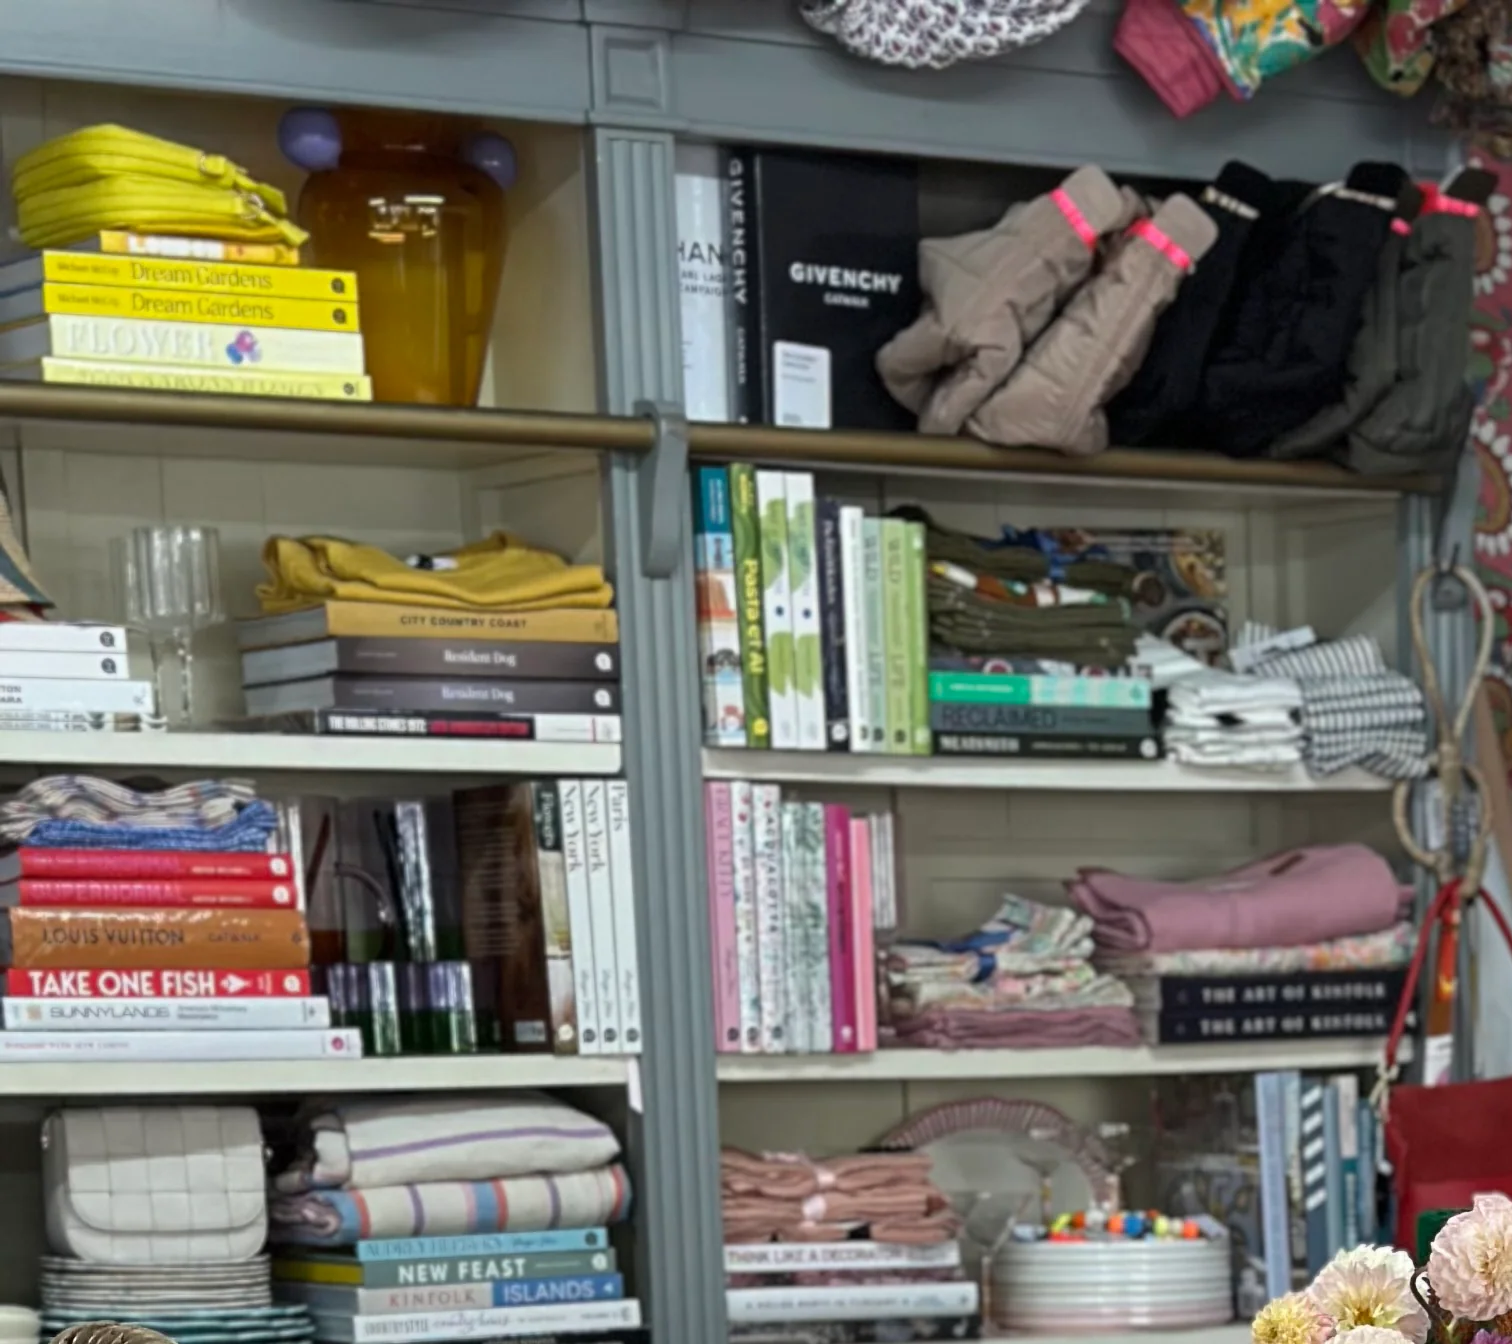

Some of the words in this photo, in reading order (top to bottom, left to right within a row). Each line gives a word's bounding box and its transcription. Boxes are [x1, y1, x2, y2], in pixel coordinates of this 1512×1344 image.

[729, 159, 748, 305] GIVENCHY
[130, 262, 193, 284] Dream
[196, 266, 273, 290] Gardens
[788, 262, 903, 295] GIVENCHY
[131, 293, 193, 315] Dream
[196, 297, 274, 321] Gardens
[744, 559, 761, 622] Pasta
[400, 615, 426, 626] CITY
[430, 616, 486, 628] COUNTRY
[489, 617, 527, 629] COAST
[611, 784, 628, 832] Paris
[43, 928, 99, 945] LOUIS
[104, 928, 185, 945] VUITTON
[28, 971, 93, 996] TAKE
[97, 971, 154, 996] ONE
[161, 971, 216, 996] FISH
[1201, 986, 1236, 1004] THE
[1242, 985, 1277, 1003] ART
[49, 1007, 171, 1019] SUNNYLANDS
[1200, 1018, 1235, 1036] THE
[1241, 1017, 1276, 1034] ART
[398, 1263, 448, 1283] NEW
[458, 1258, 527, 1281] FEAST
[389, 1290, 477, 1308] KINFOLK
[503, 1280, 596, 1303] ISLANDS
